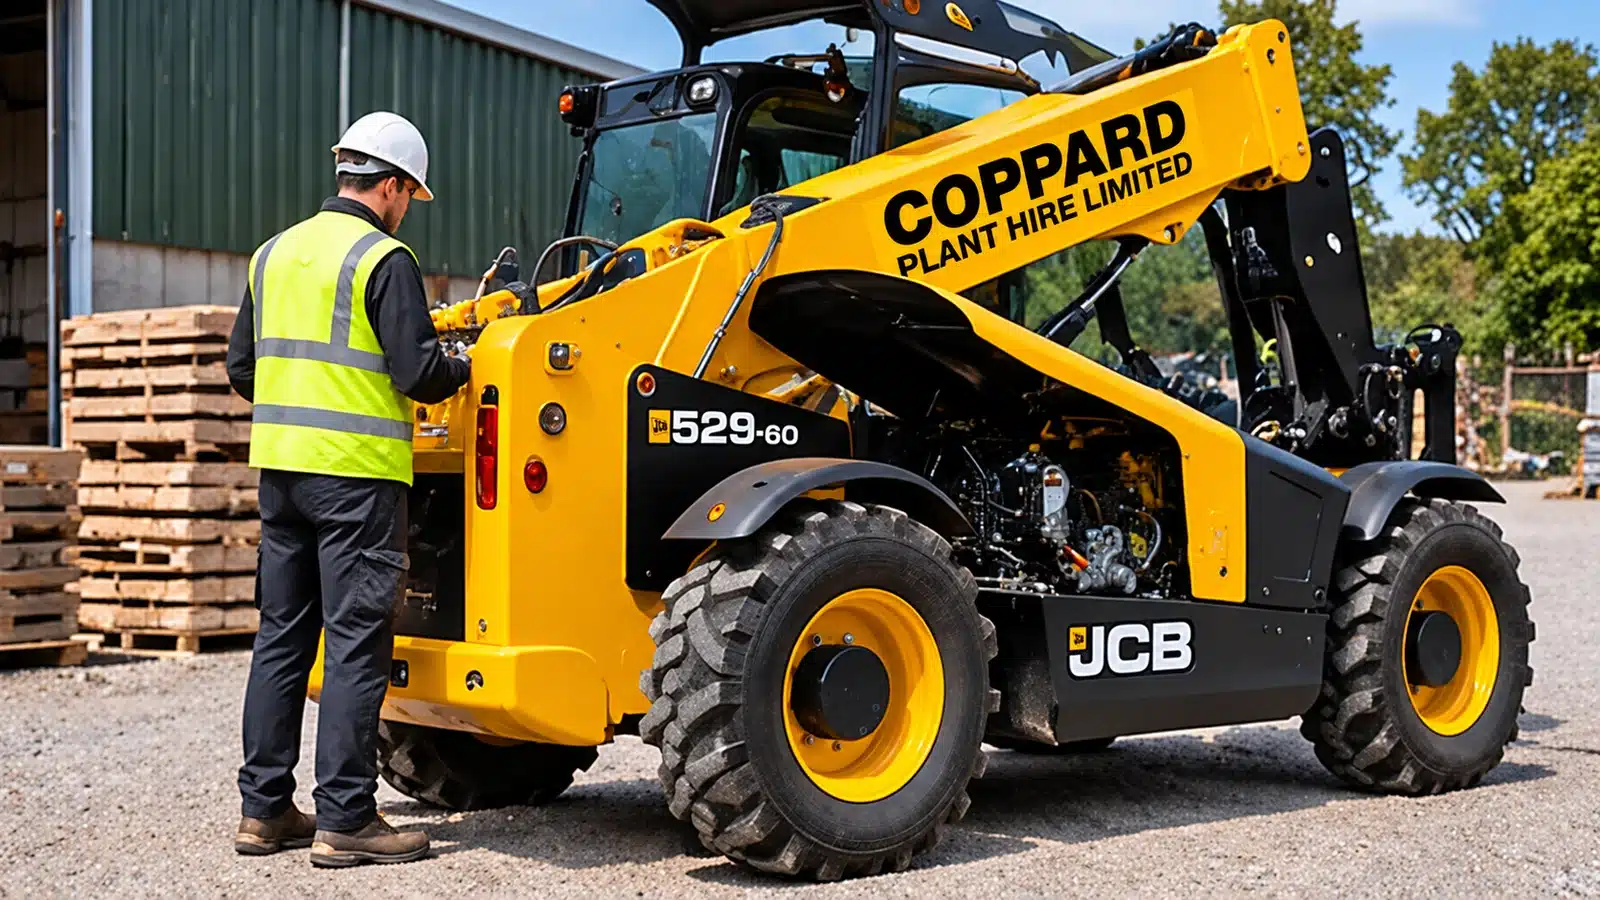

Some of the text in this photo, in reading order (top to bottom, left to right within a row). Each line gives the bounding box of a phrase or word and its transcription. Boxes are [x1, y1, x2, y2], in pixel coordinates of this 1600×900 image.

[884, 100, 1186, 246] COPPARD
[896, 151, 1193, 277] PLANT HIRE LIMITED
[672, 410, 799, 445] 529-60
[1069, 621, 1192, 677] JCB
